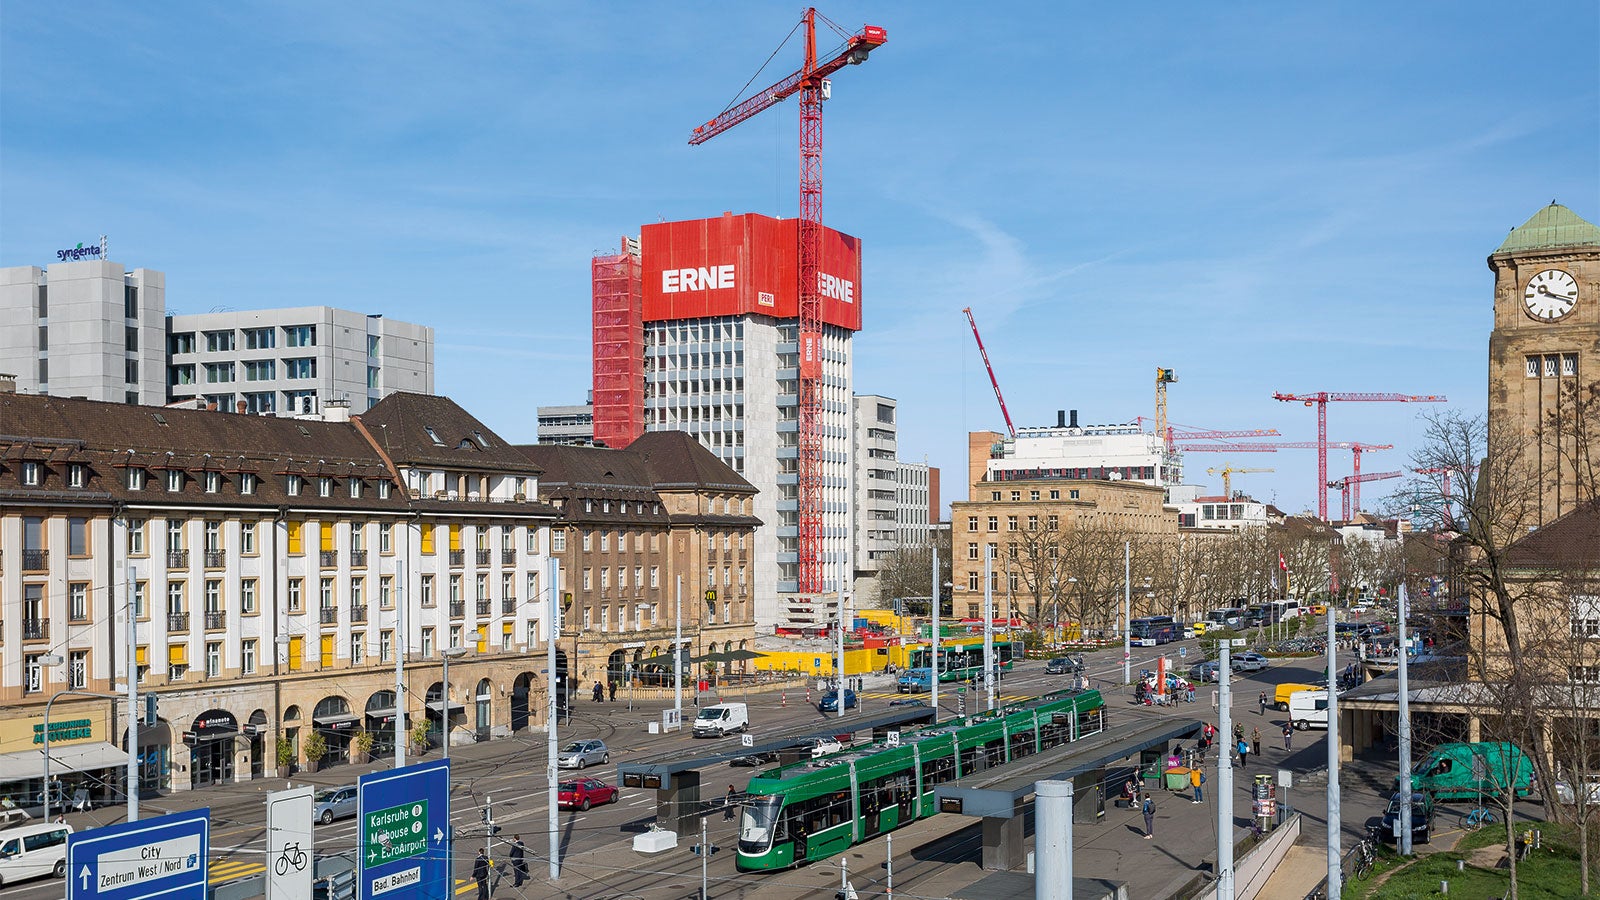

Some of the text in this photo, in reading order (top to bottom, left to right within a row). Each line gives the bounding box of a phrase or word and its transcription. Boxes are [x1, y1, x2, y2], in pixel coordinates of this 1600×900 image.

[57, 245, 101, 261] syngenta
[662, 264, 735, 294] ERNE
[761, 293, 773, 303] PERI
[805, 337, 813, 362] ERNE
[33, 719, 92, 733] HIZBRUNNEN
[743, 737, 751, 745] 45
[889, 734, 898, 742] 45
[371, 809, 409, 828] Karlsruhe
[371, 827, 409, 845] Mhouse
[140, 846, 162, 860] City
[101, 871, 135, 888] Zentrum
[138, 864, 158, 879] West
[165, 857, 181, 873] Nord
[374, 869, 419, 891] Bad. Bahnhof
